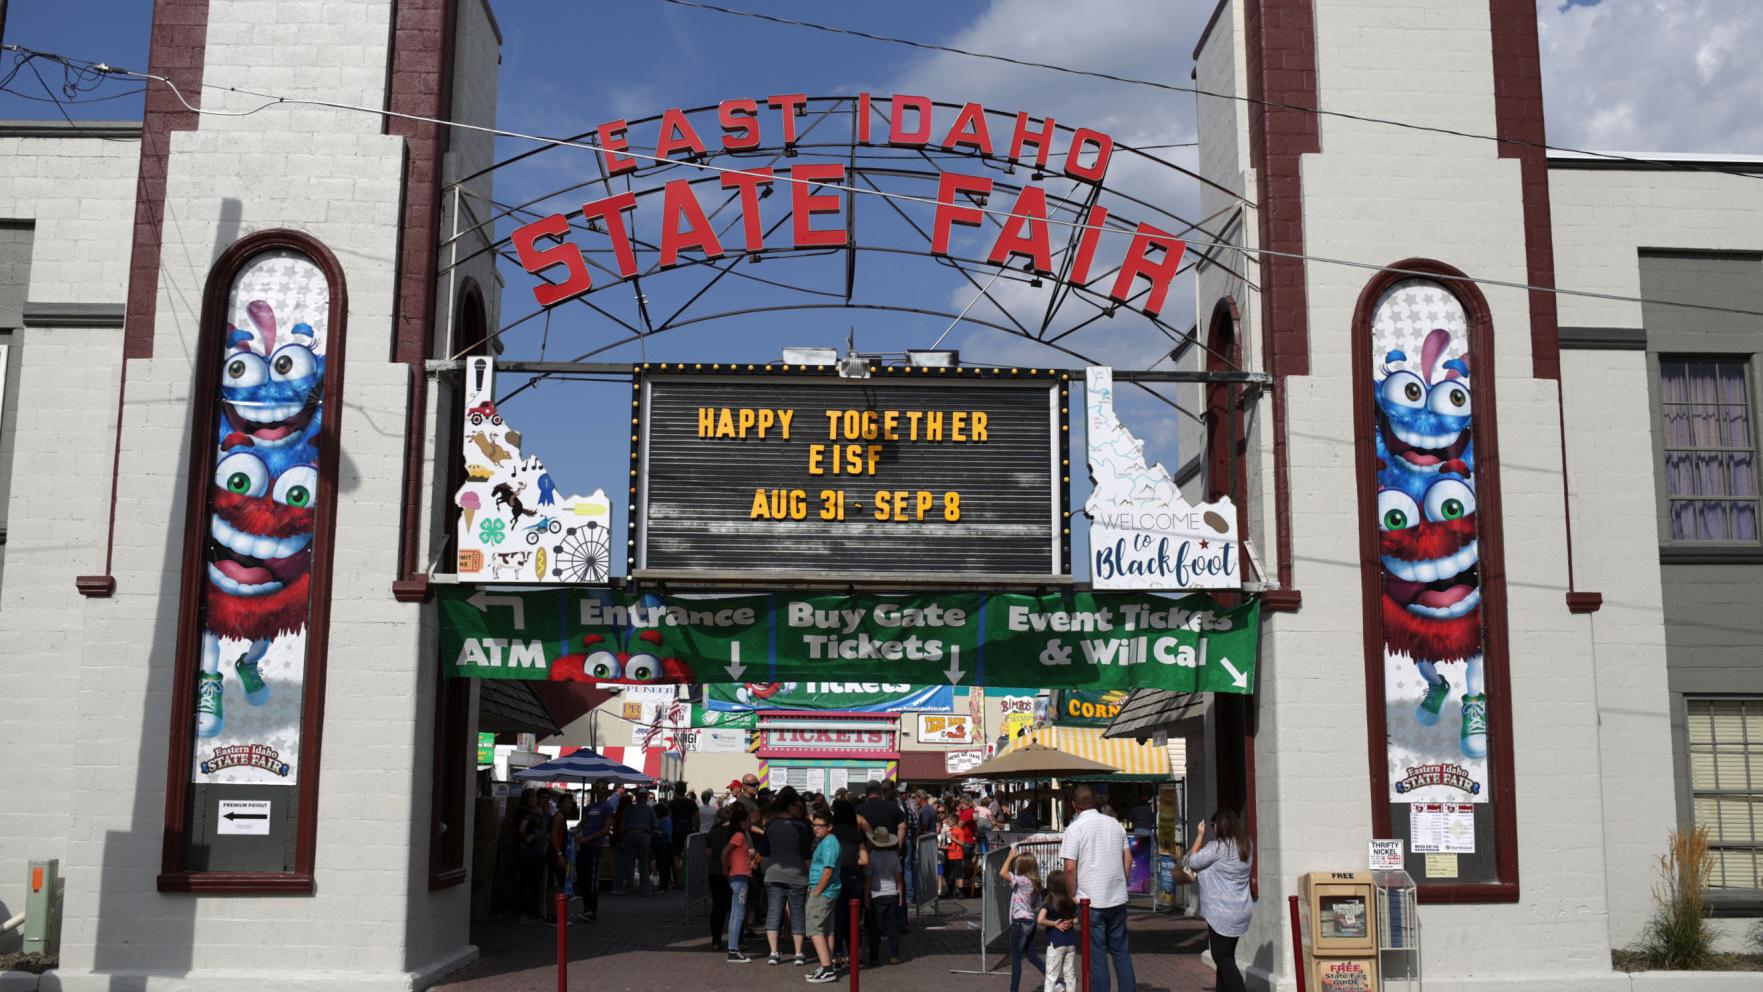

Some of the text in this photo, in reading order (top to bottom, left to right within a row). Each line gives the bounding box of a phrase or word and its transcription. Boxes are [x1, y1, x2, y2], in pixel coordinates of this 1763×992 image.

[597, 92, 1114, 183] EAST IDAHO
[511, 164, 1187, 317] STATE FAIR
[698, 408, 988, 441] HAPPY TOGETHER
[809, 444, 883, 475] EISF
[751, 488, 807, 520] AUG
[820, 490, 844, 521] 31
[874, 491, 934, 521] SEP
[944, 491, 960, 521] 8
[1101, 513, 1200, 530] WELCOME
[1134, 533, 1154, 551] to
[1096, 537, 1236, 587] Blackfoot
[580, 599, 756, 628] Entrance
[787, 602, 966, 633] Buy Gate
[1008, 604, 1232, 632] Event Tickets
[456, 638, 546, 668] ATM
[803, 634, 943, 661] Tickets
[1039, 639, 1072, 666] &
[1082, 637, 1147, 665] Will
[1068, 699, 1120, 718] CORN
[775, 730, 883, 743] TICKETS
[207, 753, 283, 774] STATE FAIR
[215, 744, 279, 758] Eastern Idaho
[1402, 773, 1474, 793] STATE FAIR
[1408, 764, 1468, 777] Eastern Idaho
